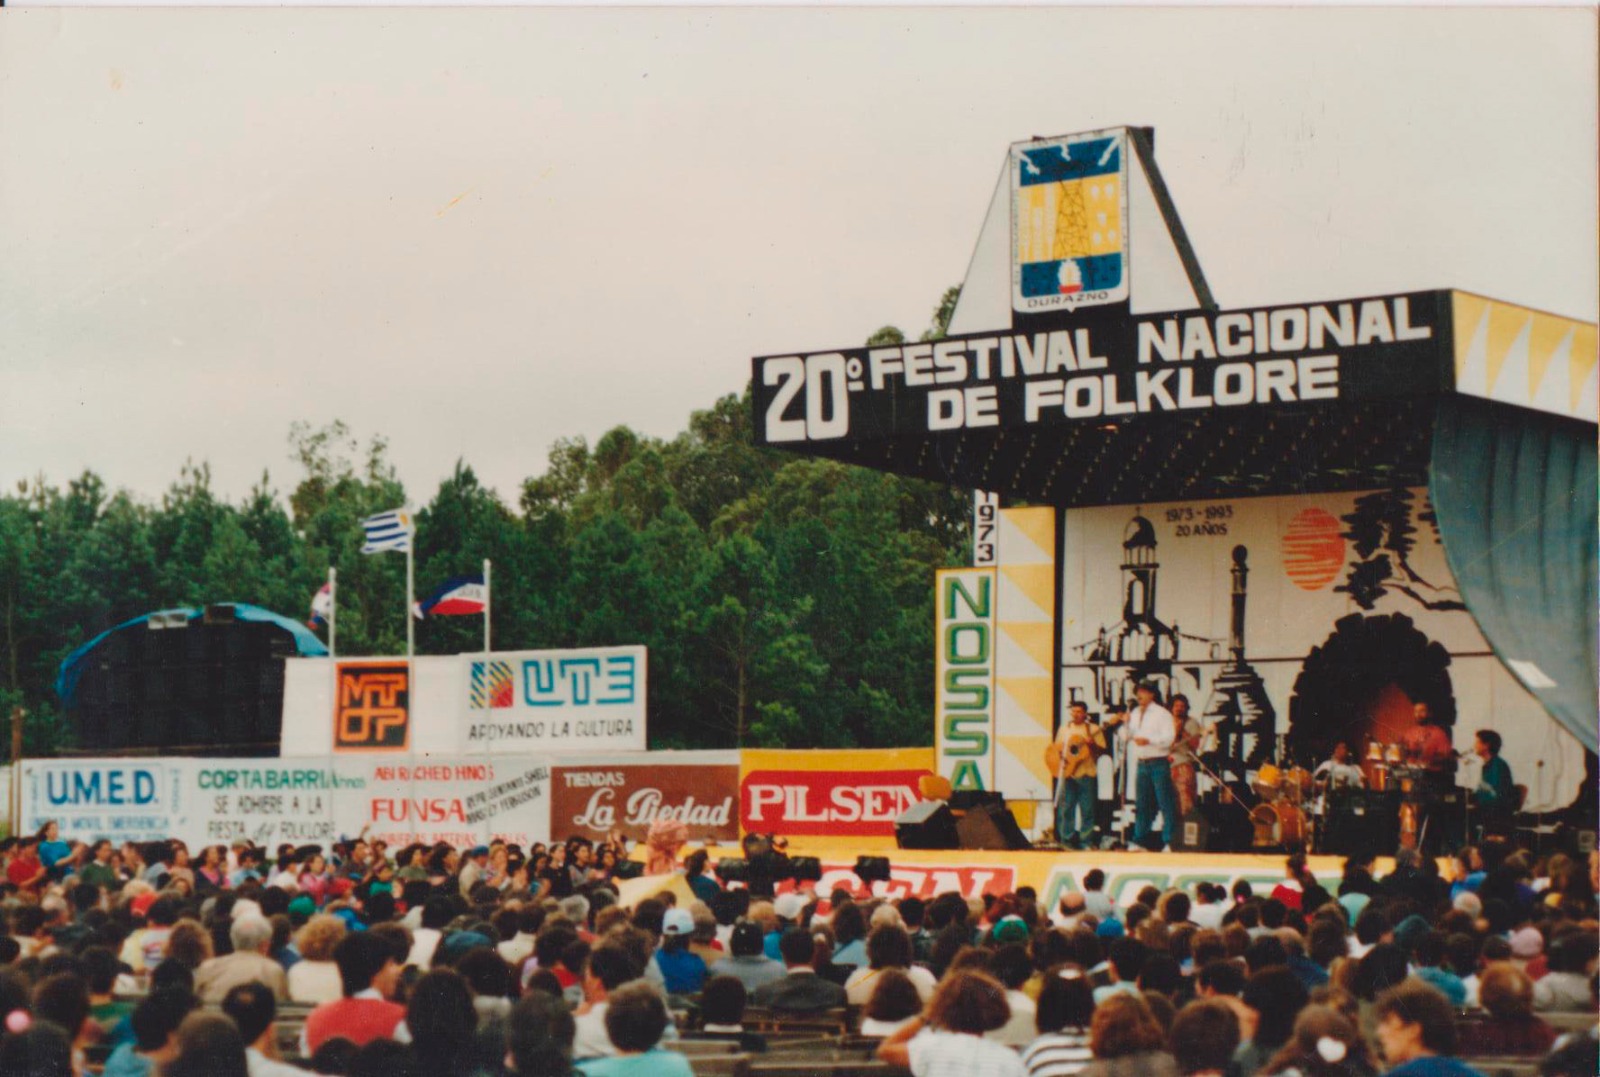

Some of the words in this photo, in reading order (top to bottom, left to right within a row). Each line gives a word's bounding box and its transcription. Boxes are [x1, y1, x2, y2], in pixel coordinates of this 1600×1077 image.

[1027, 290, 1109, 309] DURAZNO
[869, 328, 1108, 391] FESTIVAL
[1138, 297, 1432, 364] NACIONAL
[927, 385, 999, 431] DE
[1025, 355, 1340, 423] FOLKLORE
[1175, 524, 1191, 537] 20
[522, 656, 635, 706] UTE
[551, 722, 569, 737] LA
[575, 719, 634, 737] CULTURA
[47, 770, 159, 805] U.M.E.D.
[563, 772, 625, 788] TIENDAS
[214, 795, 228, 814] SE
[291, 795, 299, 814] A
[308, 795, 323, 814] LA
[371, 798, 467, 823] FUNSA
[573, 788, 616, 831] La
[625, 788, 734, 826] Piedad
